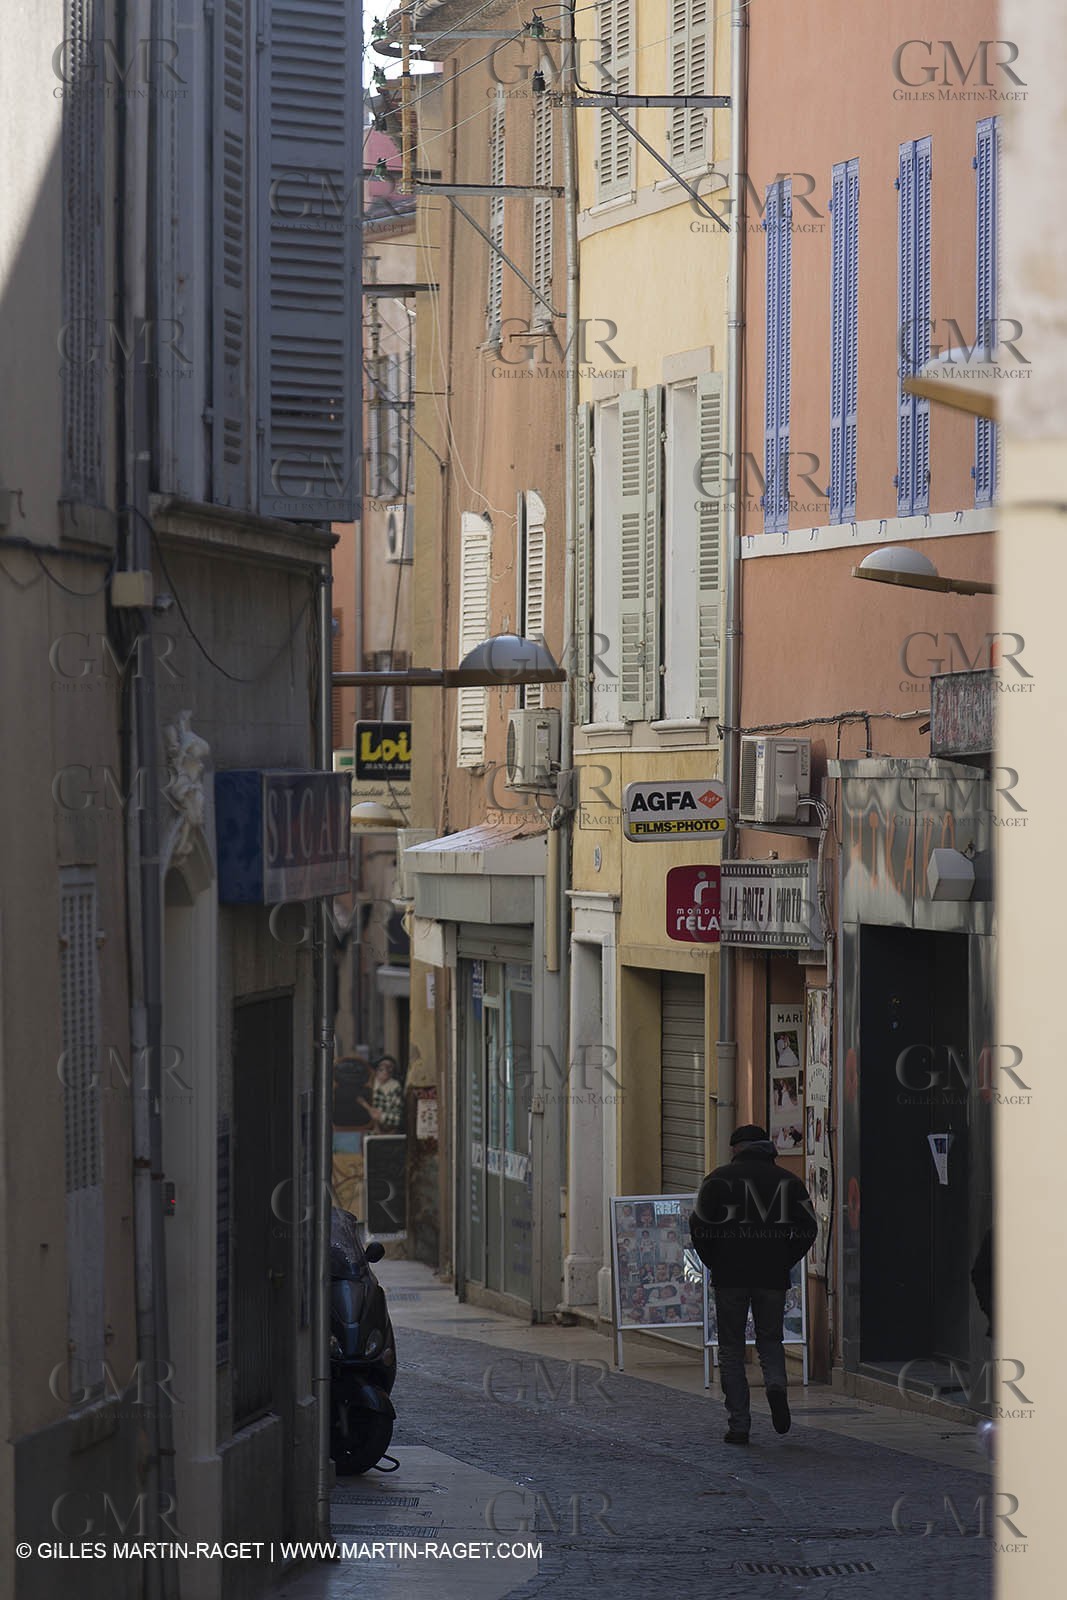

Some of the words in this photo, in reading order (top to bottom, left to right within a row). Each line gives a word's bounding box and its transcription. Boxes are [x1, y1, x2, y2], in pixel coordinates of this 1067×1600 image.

[361, 731, 411, 761] Loi
[630, 791, 698, 812] AGFA
[635, 820, 720, 833] FILMS-PHOTO
[728, 886, 738, 921] LA
[742, 886, 765, 922] BOITE
[767, 887, 772, 922] A
[776, 887, 802, 923] PHOTO
[676, 916, 720, 931] RELA
[777, 1011, 803, 1023] MARI
